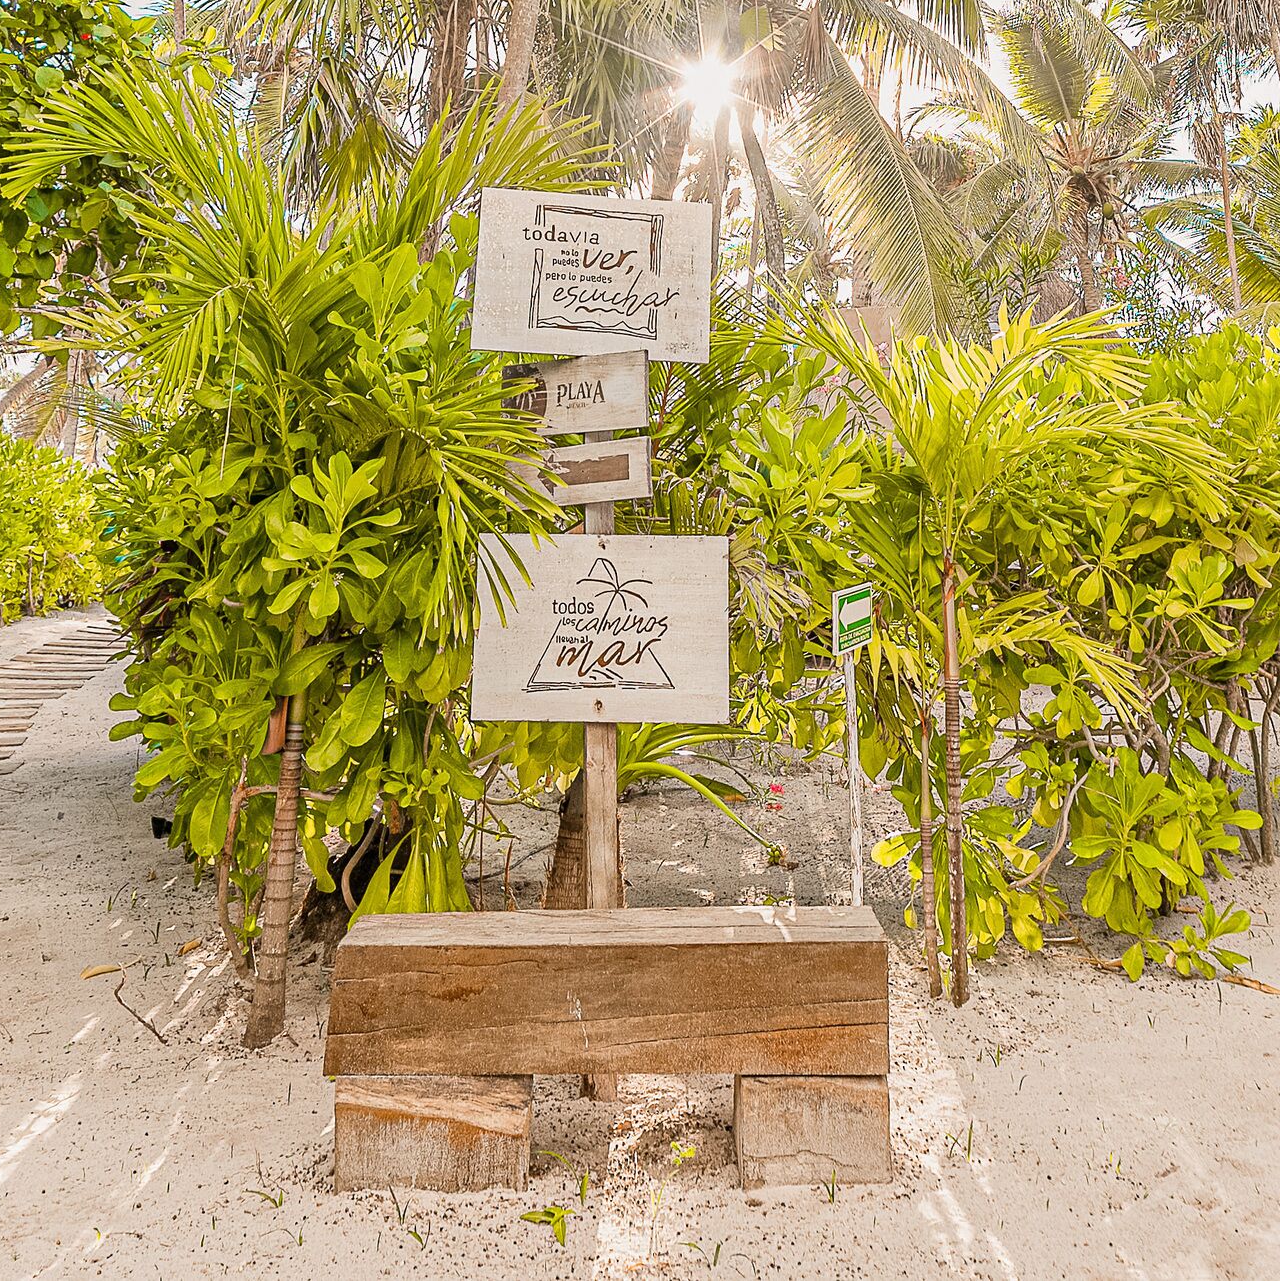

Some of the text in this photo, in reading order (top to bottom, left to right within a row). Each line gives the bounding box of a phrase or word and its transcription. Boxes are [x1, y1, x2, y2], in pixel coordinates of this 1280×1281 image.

[552, 258, 580, 268] puedes
[582, 249, 638, 275] ver,
[545, 272, 613, 284] pero lo puedes
[552, 269, 680, 317] escuchar
[556, 380, 606, 407] PLAYA
[551, 596, 595, 615] todos
[562, 608, 669, 638] los caminos
[555, 635, 589, 644] llevan al
[556, 638, 662, 677] mar
